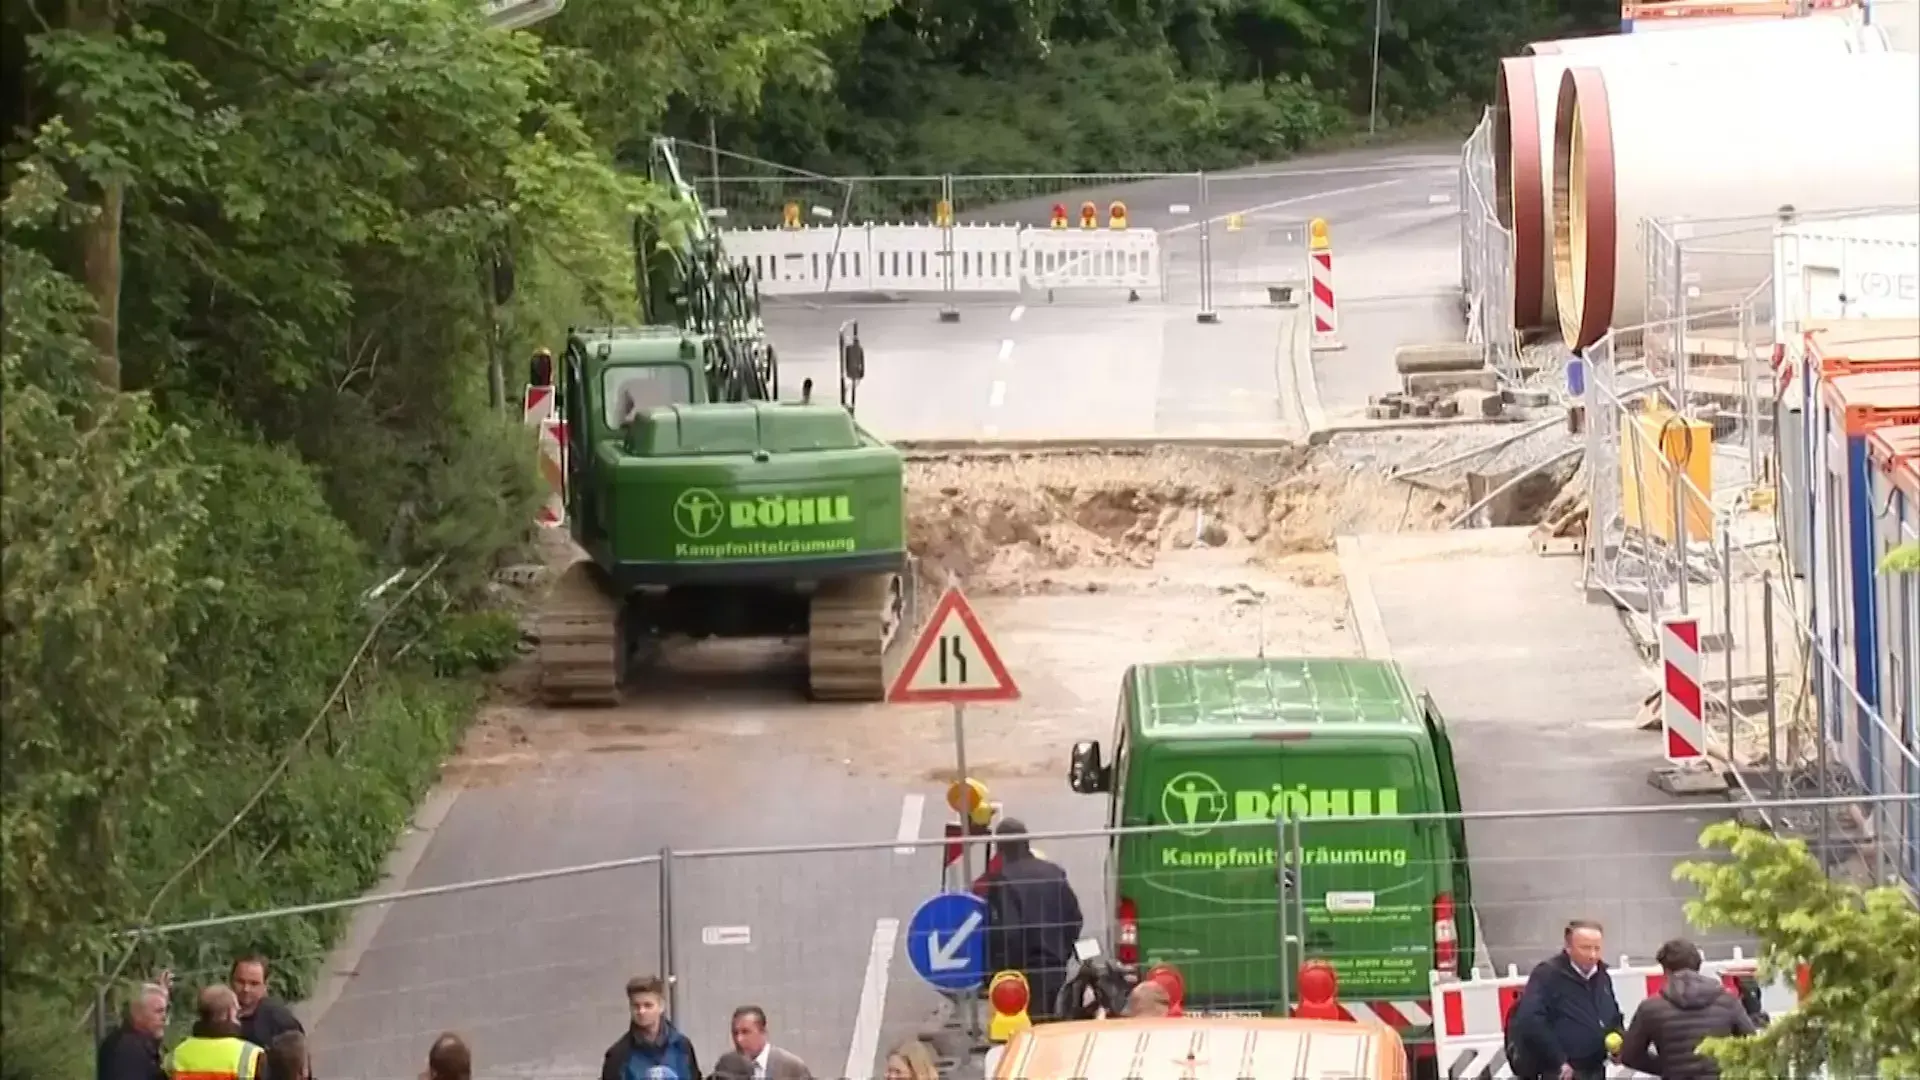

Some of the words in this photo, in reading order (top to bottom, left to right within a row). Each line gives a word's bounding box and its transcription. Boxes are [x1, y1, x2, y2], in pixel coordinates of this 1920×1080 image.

[729, 495, 854, 528] RÖHLL
[675, 538, 855, 558] Kampfmittelräumung
[1162, 847, 1406, 871] Kampfmitelräumung
